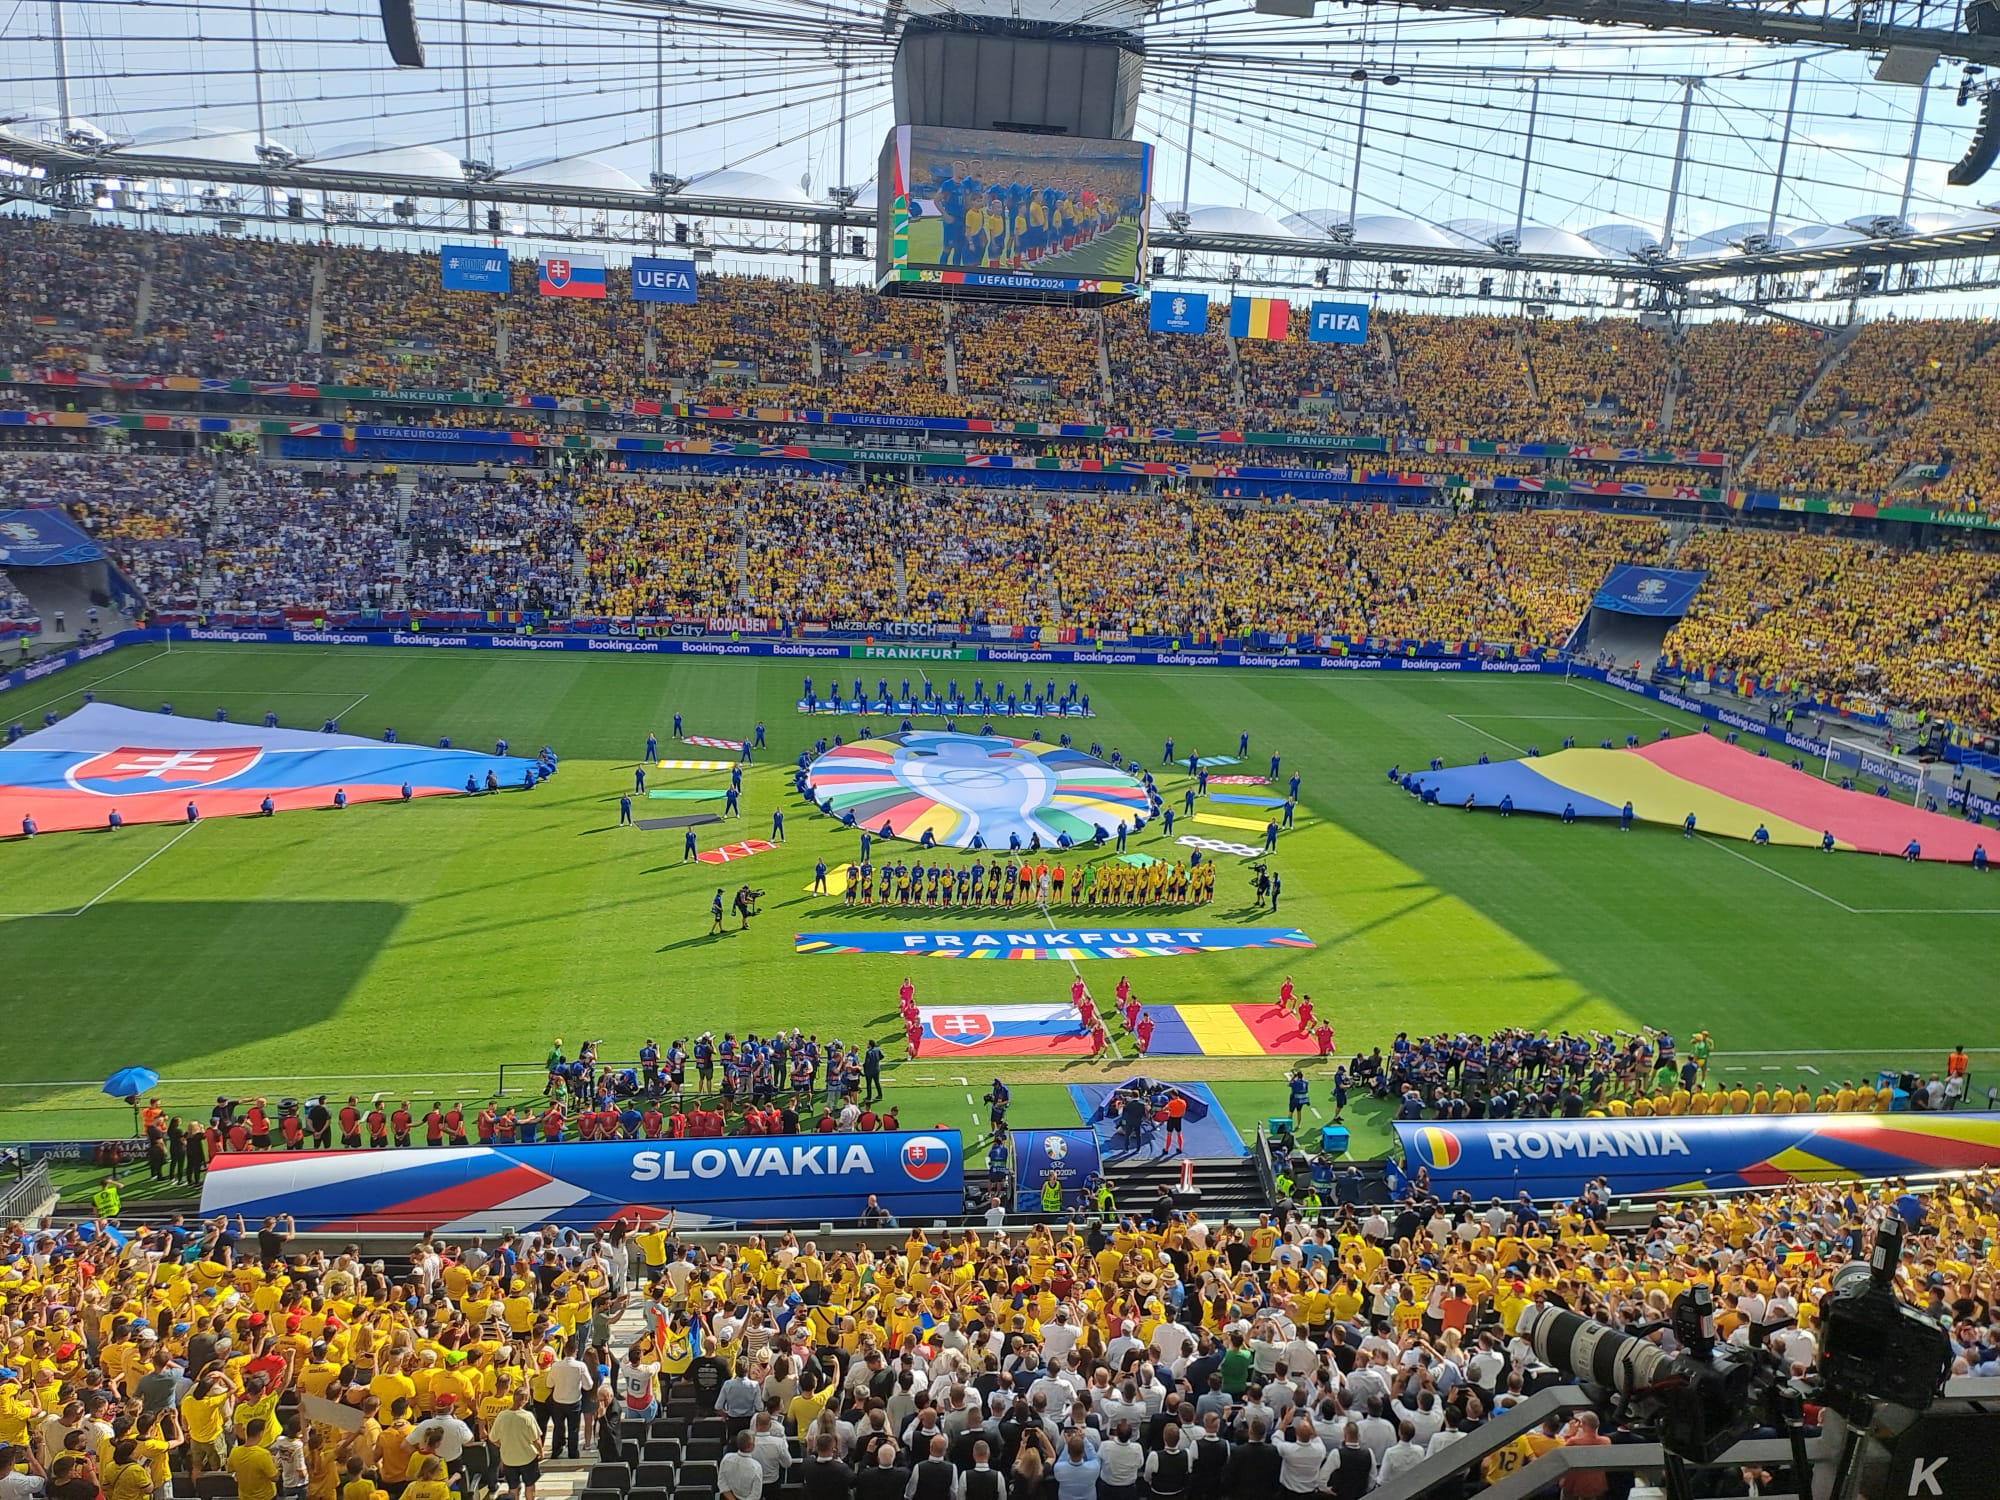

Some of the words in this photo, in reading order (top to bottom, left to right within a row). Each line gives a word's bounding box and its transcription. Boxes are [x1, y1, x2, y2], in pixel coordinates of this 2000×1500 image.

[637, 271, 691, 290] UEFA
[978, 275, 1065, 289] UEFAEURO2024
[1318, 313, 1360, 331] FIFA
[372, 390, 453, 402] FRANKFURT
[851, 416, 924, 427] UEFAEURO2024
[373, 428, 460, 440] UEFAEURO2024
[1286, 436, 1355, 447] FRANKFURT
[853, 451, 922, 462] FRANKFURT
[1280, 470, 1348, 481] UEFAEURO202
[671, 623, 704, 637] City
[710, 618, 768, 632] RODALBEN
[831, 620, 882, 631] HARZBURG
[885, 622, 937, 637] KETSCH
[190, 629, 268, 642] Booking.com
[293, 631, 368, 645] Booking.com
[393, 634, 467, 647] Booking.com
[491, 635, 564, 649] Booking.com
[588, 639, 658, 652] Booking.com
[682, 641, 750, 655] Booking.com
[773, 644, 839, 657] Booking.com
[866, 647, 963, 660] FRANKFURT
[988, 650, 1052, 662] Booking.com
[1073, 653, 1136, 665] Booking.com
[1157, 654, 1219, 666] Booking.com
[1239, 655, 1300, 667] Booking.com
[1320, 657, 1381, 669] Booking.com
[1401, 659, 1461, 671] Booking.com
[1481, 660, 1541, 672] Booking.com
[1606, 673, 1644, 693] Booking.com
[1659, 690, 1702, 714] Booking.com
[1717, 710, 1766, 735] Booking.com
[903, 931, 1204, 948] FRANKFURT
[1486, 1129, 1691, 1160] ROMANIA
[43, 1150, 80, 1159] QATAR
[630, 1144, 875, 1182] SLOVAKIA
[1262, 1237, 1272, 1248] 10
[1404, 1318, 1419, 1329] 10
[1499, 1451, 1518, 1472] 12
[1908, 1457, 1949, 1497] K
